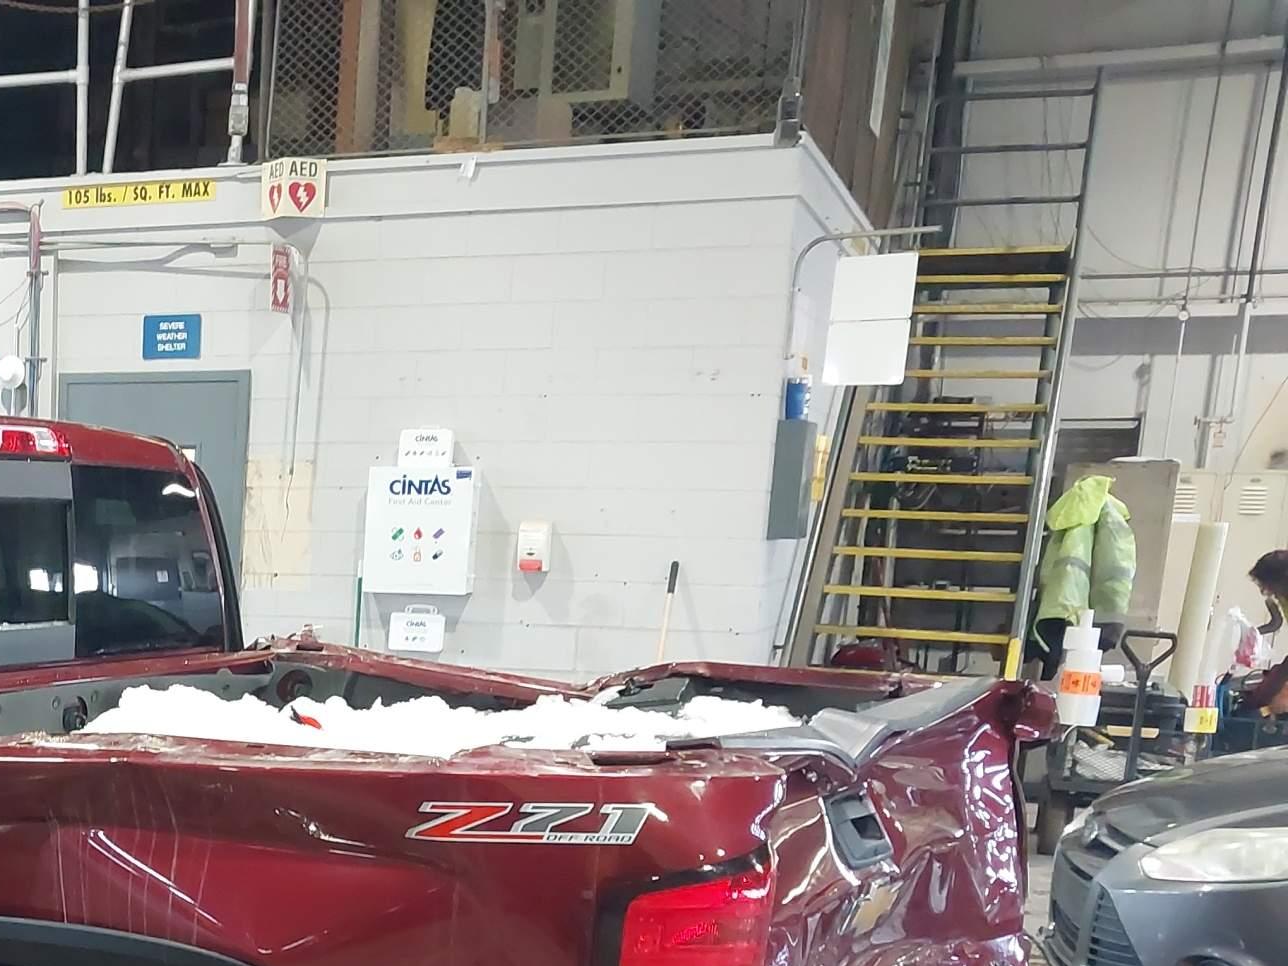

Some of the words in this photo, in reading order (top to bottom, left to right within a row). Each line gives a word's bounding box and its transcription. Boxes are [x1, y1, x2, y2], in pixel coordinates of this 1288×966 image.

[269, 161, 284, 180] AED
[289, 160, 318, 177] AED
[68, 189, 90, 205] 105
[95, 186, 117, 203] lbs.
[122, 186, 128, 202] /
[133, 185, 152, 201] SQ.
[158, 184, 175, 199] FT.
[181, 181, 210, 198] MAX
[159, 321, 185, 331] SEVERE
[156, 332, 188, 341] WEATHER
[157, 342, 186, 352] SHELTER
[405, 801, 655, 845] Z71
[583, 833, 632, 843] ROAD
